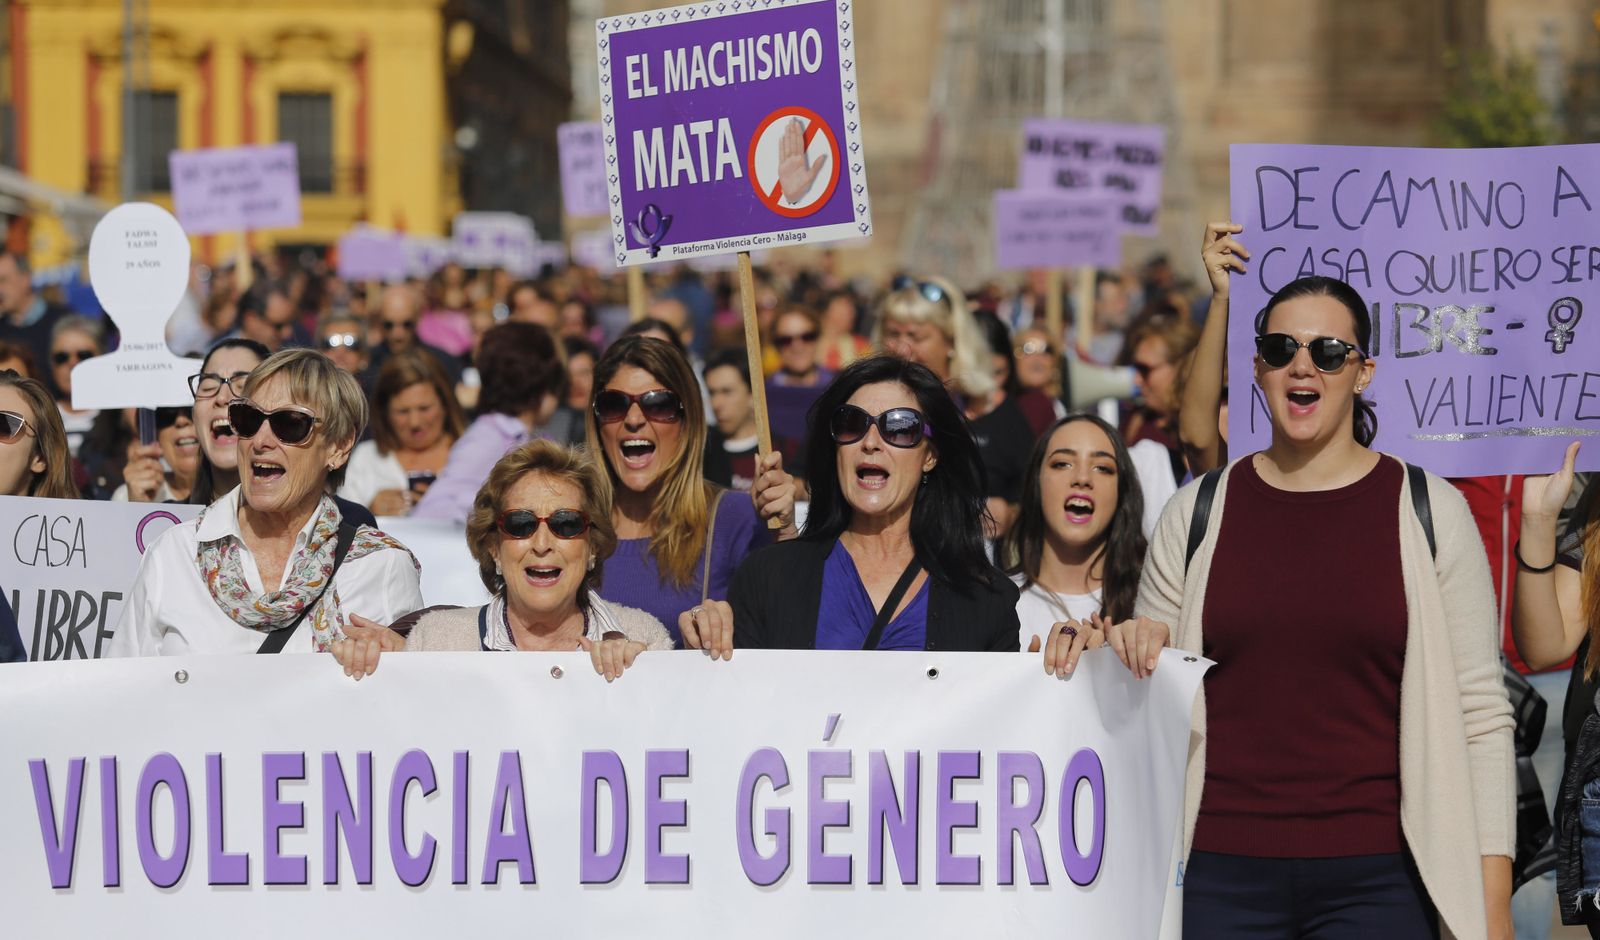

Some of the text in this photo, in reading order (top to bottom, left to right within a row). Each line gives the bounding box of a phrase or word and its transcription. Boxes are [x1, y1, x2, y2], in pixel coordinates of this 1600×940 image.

[626, 28, 823, 99] EL MACHISMO
[633, 117, 743, 191] MATA
[1256, 165, 1592, 232] DE CAMINO A
[672, 242, 715, 255] Plataforma
[716, 237, 751, 249] Violencia
[753, 234, 771, 245] Cero
[777, 231, 807, 243] Málaga
[1259, 247, 1372, 296] CASA
[1385, 248, 1542, 296] QUIERO
[1371, 302, 1498, 358] IBRE
[116, 363, 172, 372] TARRAGONA
[1405, 372, 1600, 428] VALIENTE
[13, 514, 87, 568] CASA
[28, 713, 1106, 889] VIOLENCIA DE GÉNERO
